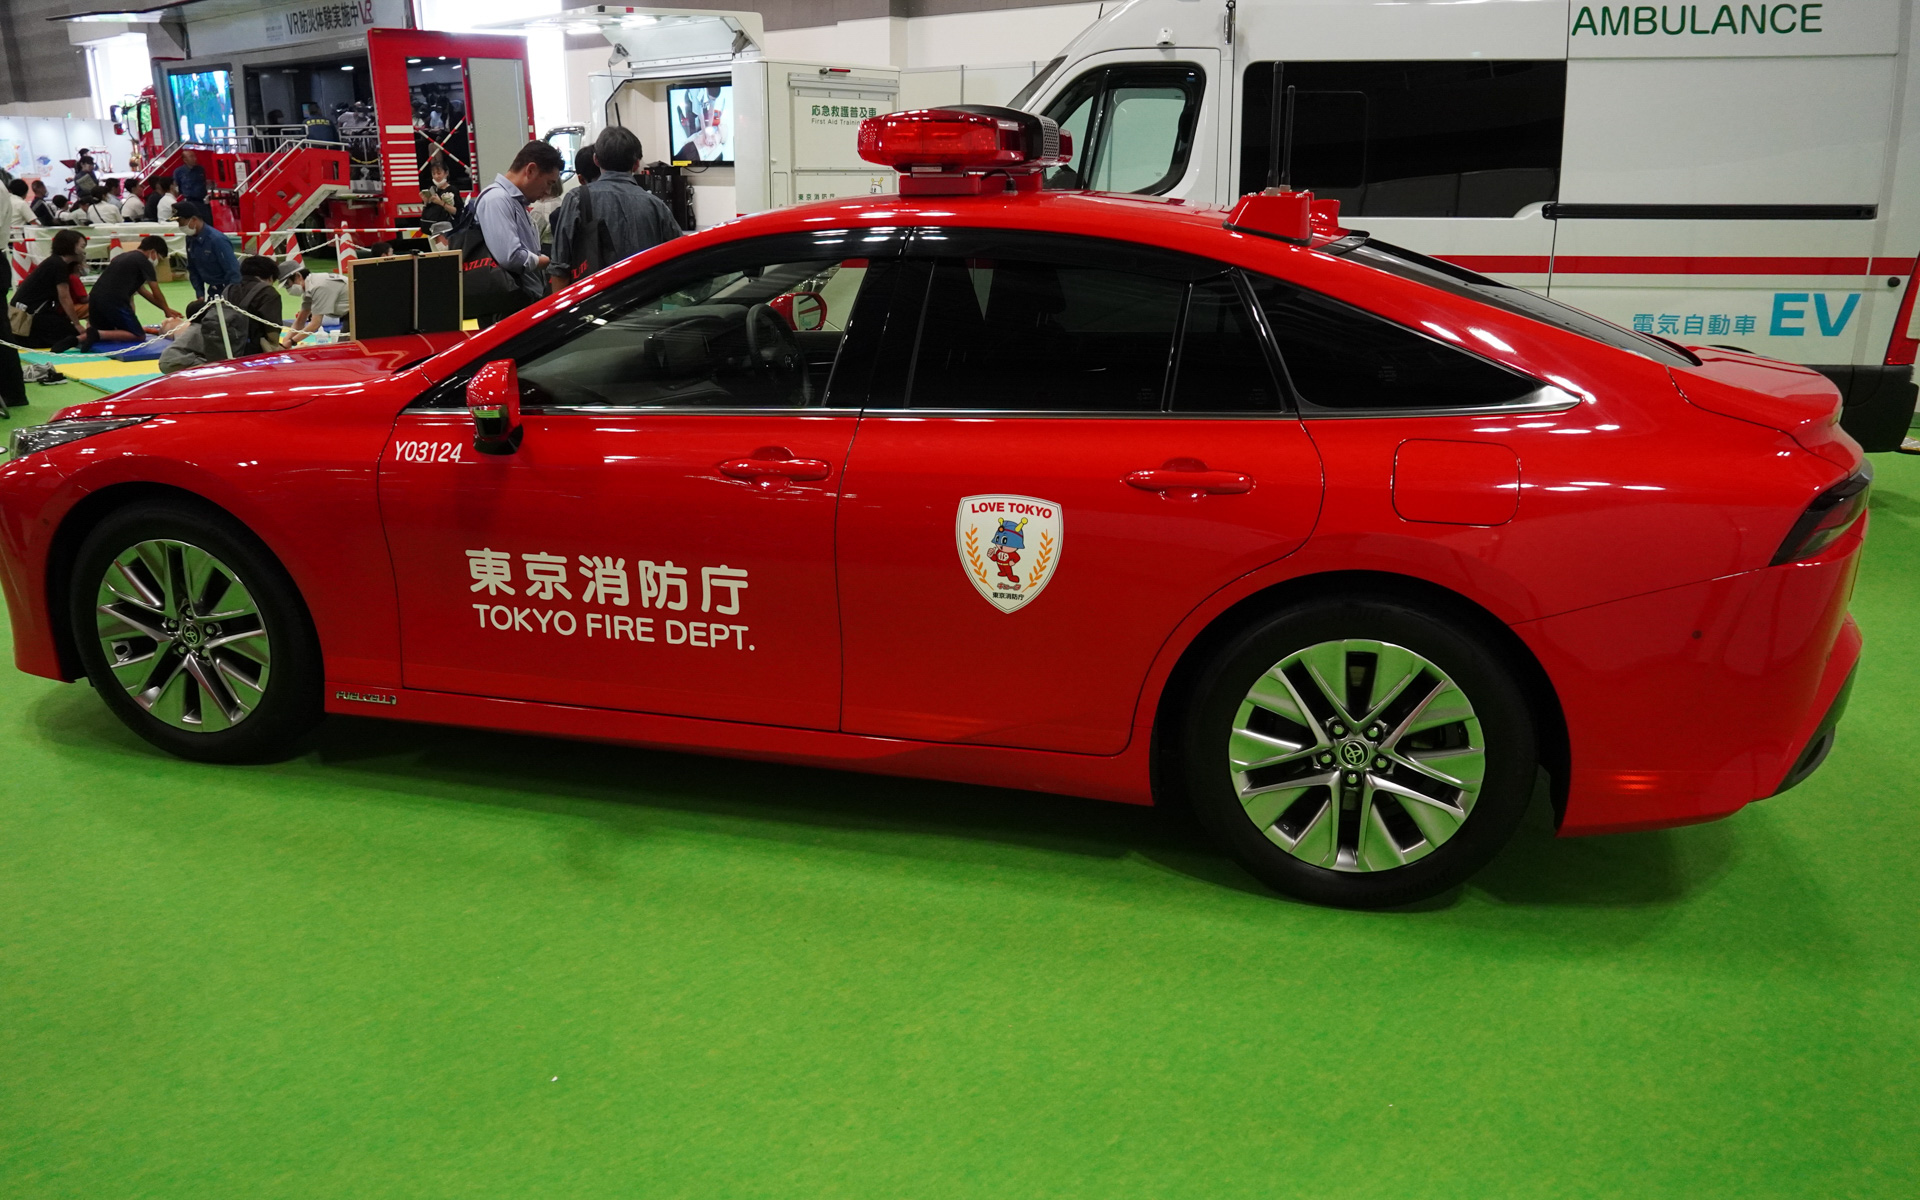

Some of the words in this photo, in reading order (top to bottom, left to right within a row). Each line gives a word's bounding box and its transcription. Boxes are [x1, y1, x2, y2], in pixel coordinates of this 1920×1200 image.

[286, 1, 359, 34] VR防災体験実施中
[1571, 3, 1823, 36] AMBULANCE
[811, 104, 877, 118] 応急救護普及車
[1632, 313, 1757, 336] 電気自動車
[1769, 292, 1862, 337] EV
[395, 441, 463, 463] Y03124
[971, 502, 1005, 514] LOVE
[1008, 502, 1053, 519] TOKYO
[465, 547, 749, 616] 東京消防庁
[992, 592, 1025, 601] 東京消防庁
[472, 603, 577, 636] TOKYO
[586, 613, 656, 643] FIRE
[666, 619, 756, 651] DEPT.
